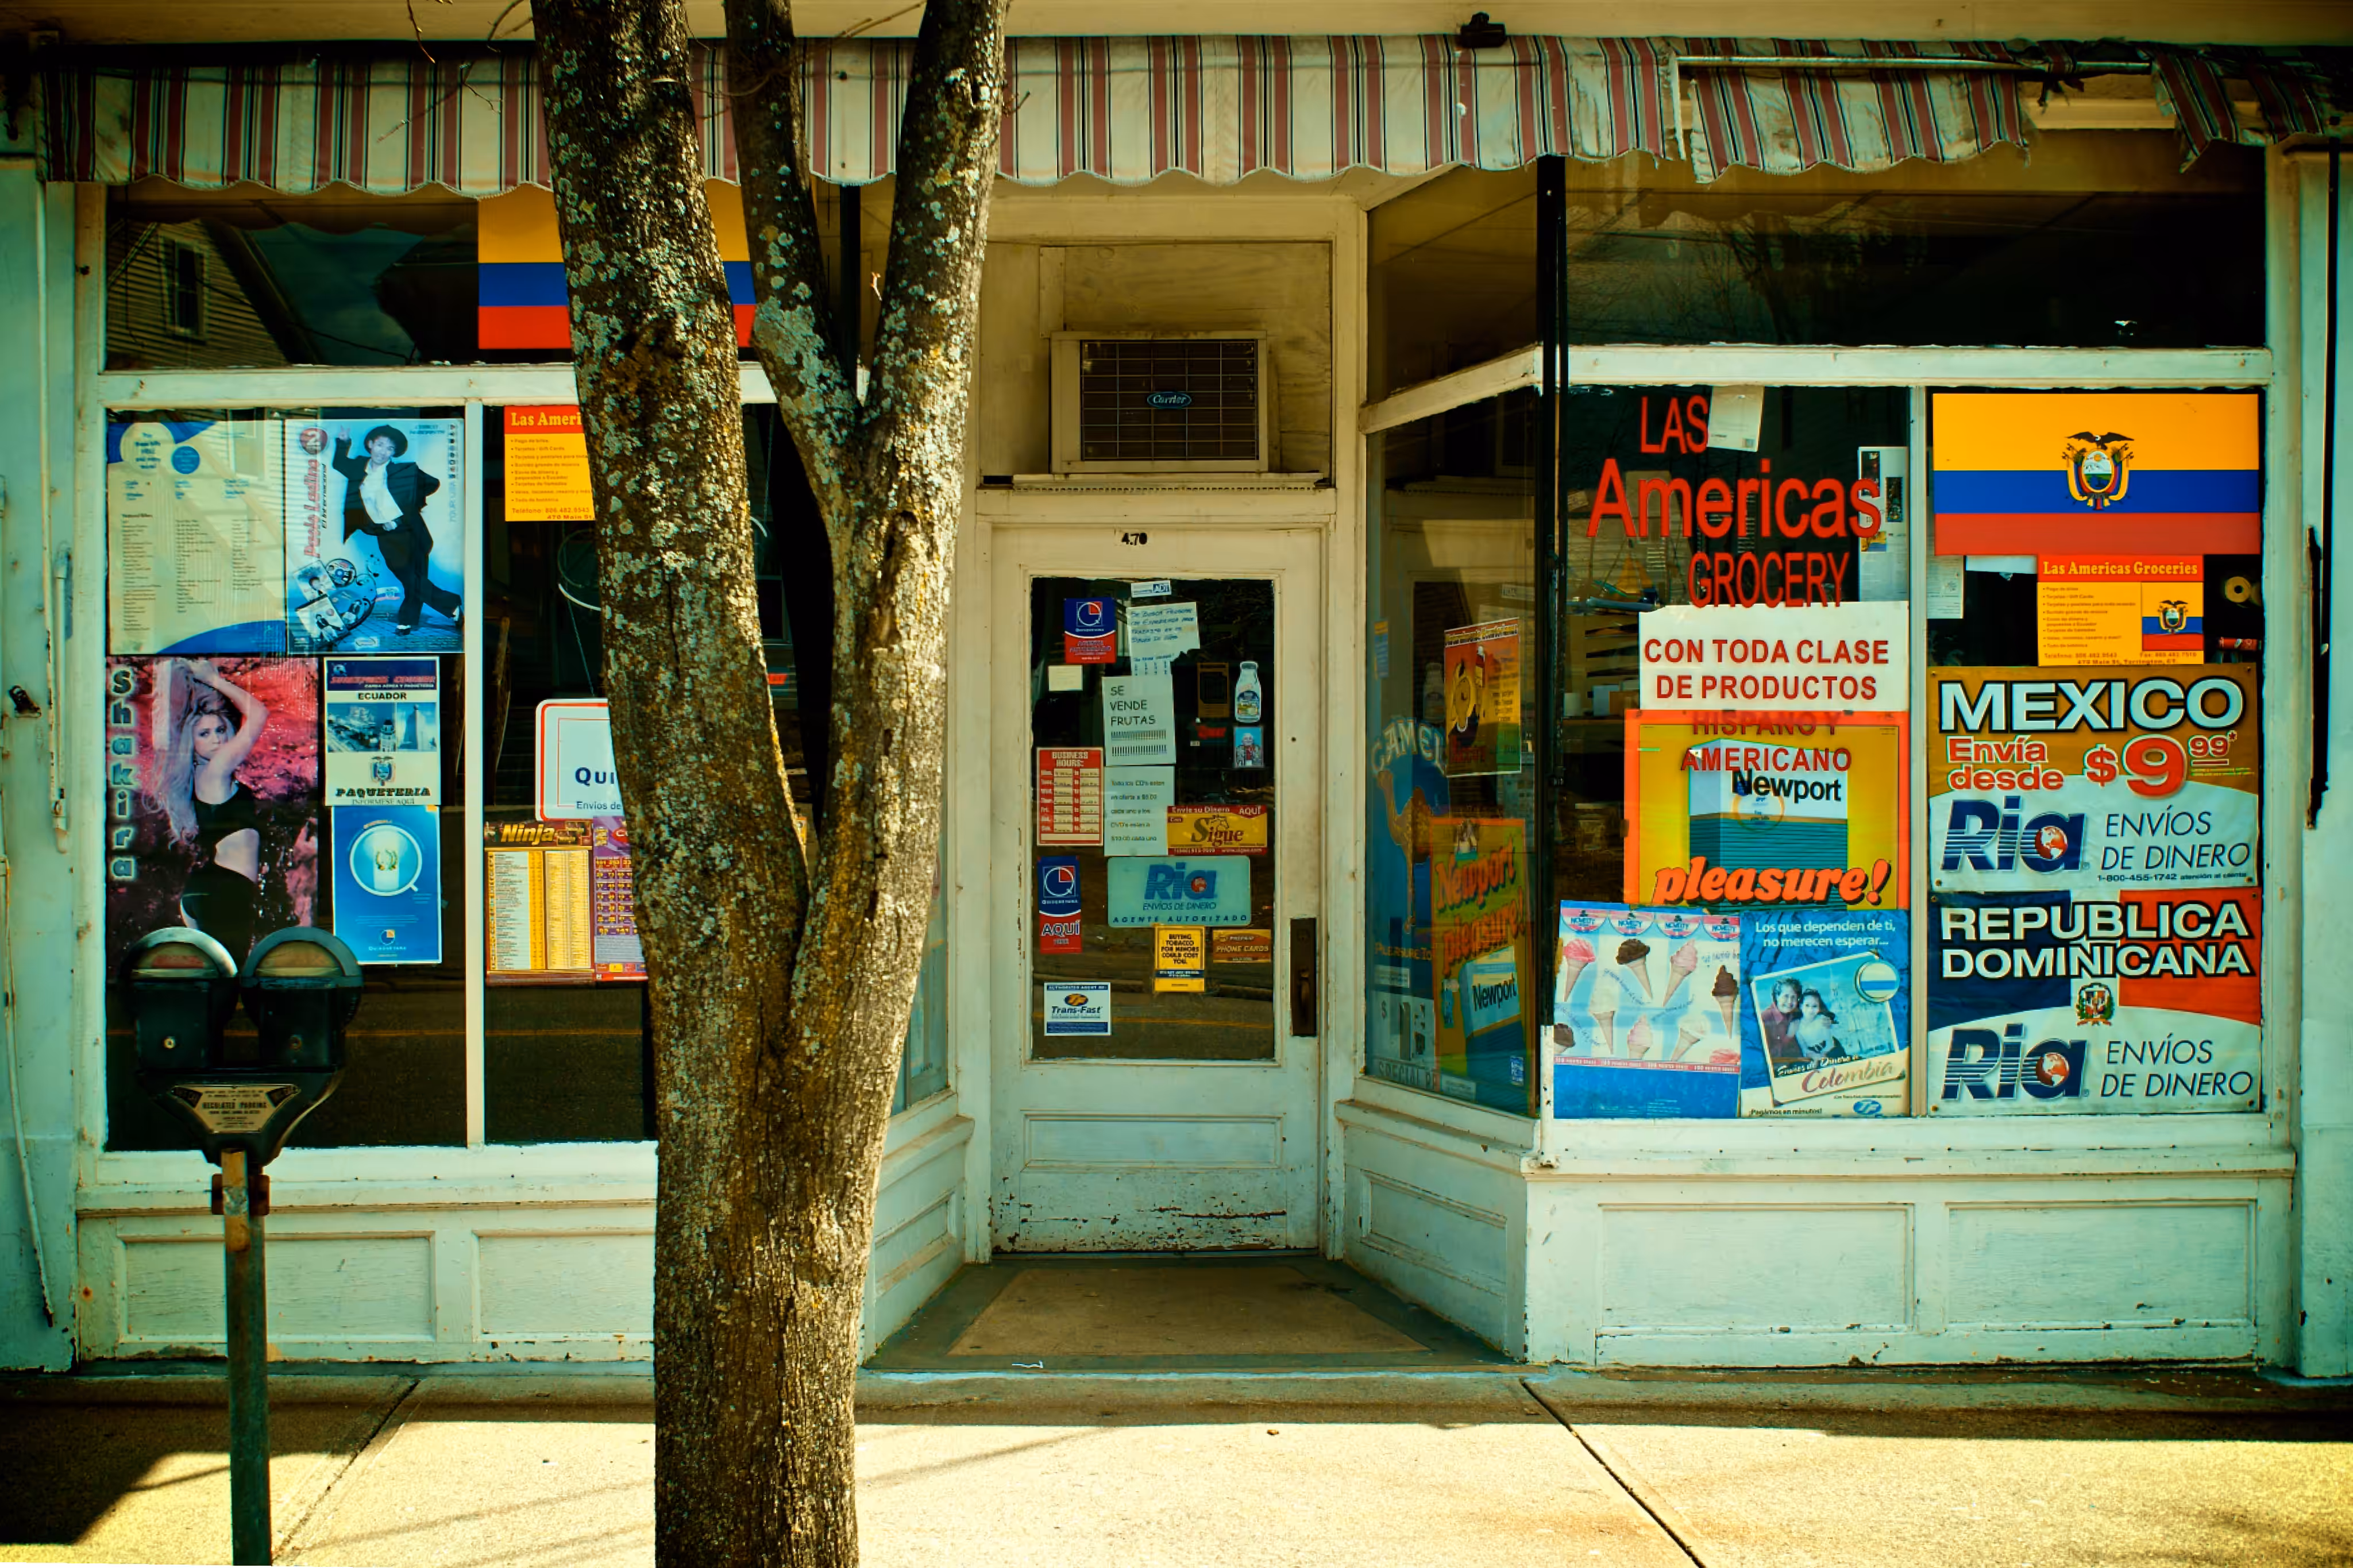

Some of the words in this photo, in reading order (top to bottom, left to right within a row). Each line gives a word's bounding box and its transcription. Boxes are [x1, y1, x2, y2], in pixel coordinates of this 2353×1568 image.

[1152, 394, 1187, 404] Carrier
[511, 412, 534, 426] Las
[538, 412, 582, 426] Ameri
[1640, 395, 1708, 454] LAS
[1586, 458, 1881, 538] Americas
[1687, 551, 1850, 608] GROCERY
[2043, 561, 2065, 574] Las
[2068, 561, 2131, 574] Americas
[2134, 561, 2197, 574] Groceries
[1645, 639, 1703, 663] CON
[1712, 639, 1789, 663] TODA
[1796, 639, 1888, 664] CLASE
[358, 692, 407, 700] ECUADOR
[1110, 686, 1125, 696] SE
[1657, 675, 1692, 699] DE
[1702, 675, 1877, 700] PRODUCTOS
[1110, 700, 1147, 711] VENDE
[1939, 677, 2246, 733] MEXICO
[1111, 716, 1156, 727] FRUTAS
[1693, 711, 1817, 736] HISPANO
[1822, 711, 1841, 735] Y
[1681, 747, 1852, 771] AMERICANO
[1947, 735, 2048, 763] Envía
[111, 669, 136, 879] Shakira
[575, 767, 615, 787] QUI
[1731, 768, 1842, 804] Newport
[1948, 763, 2065, 791] desde
[335, 787, 431, 798] PAQUETERIA
[610, 801, 622, 810] de
[500, 824, 556, 846] Ninja
[1191, 817, 1244, 847] Sigue
[1941, 795, 2088, 872] Ria
[2105, 805, 2212, 837] ENVÍOS
[2100, 845, 2135, 870] DE
[2144, 843, 2250, 870] DINERO
[1144, 862, 1217, 901] Ria
[1437, 839, 1515, 912] Newport
[1652, 856, 1891, 906] pleasure!
[2097, 873, 2177, 882] 1-800-455-1742
[1042, 920, 1081, 937] AQUÍ
[1756, 921, 1776, 932] Los
[1778, 923, 1802, 934] que
[1803, 920, 1865, 934] dependen
[1866, 920, 1883, 931] de
[1884, 919, 1896, 932] ti,
[1939, 901, 2254, 941] REPUBLICA
[1763, 939, 1779, 947] no
[1781, 937, 1833, 947] merecen
[1835, 936, 1889, 948] esperar...
[1941, 943, 2255, 979] DOMINICANA
[1471, 972, 1518, 1011] Newport
[1051, 1006, 1102, 1014] Trans-Fast
[1941, 1024, 2088, 1100] Ria
[2107, 1033, 2213, 1065] ENVÍOS
[1802, 1060, 1893, 1093] Colombia
[2100, 1072, 2135, 1098] DE
[2144, 1071, 2252, 1098] DINERO
